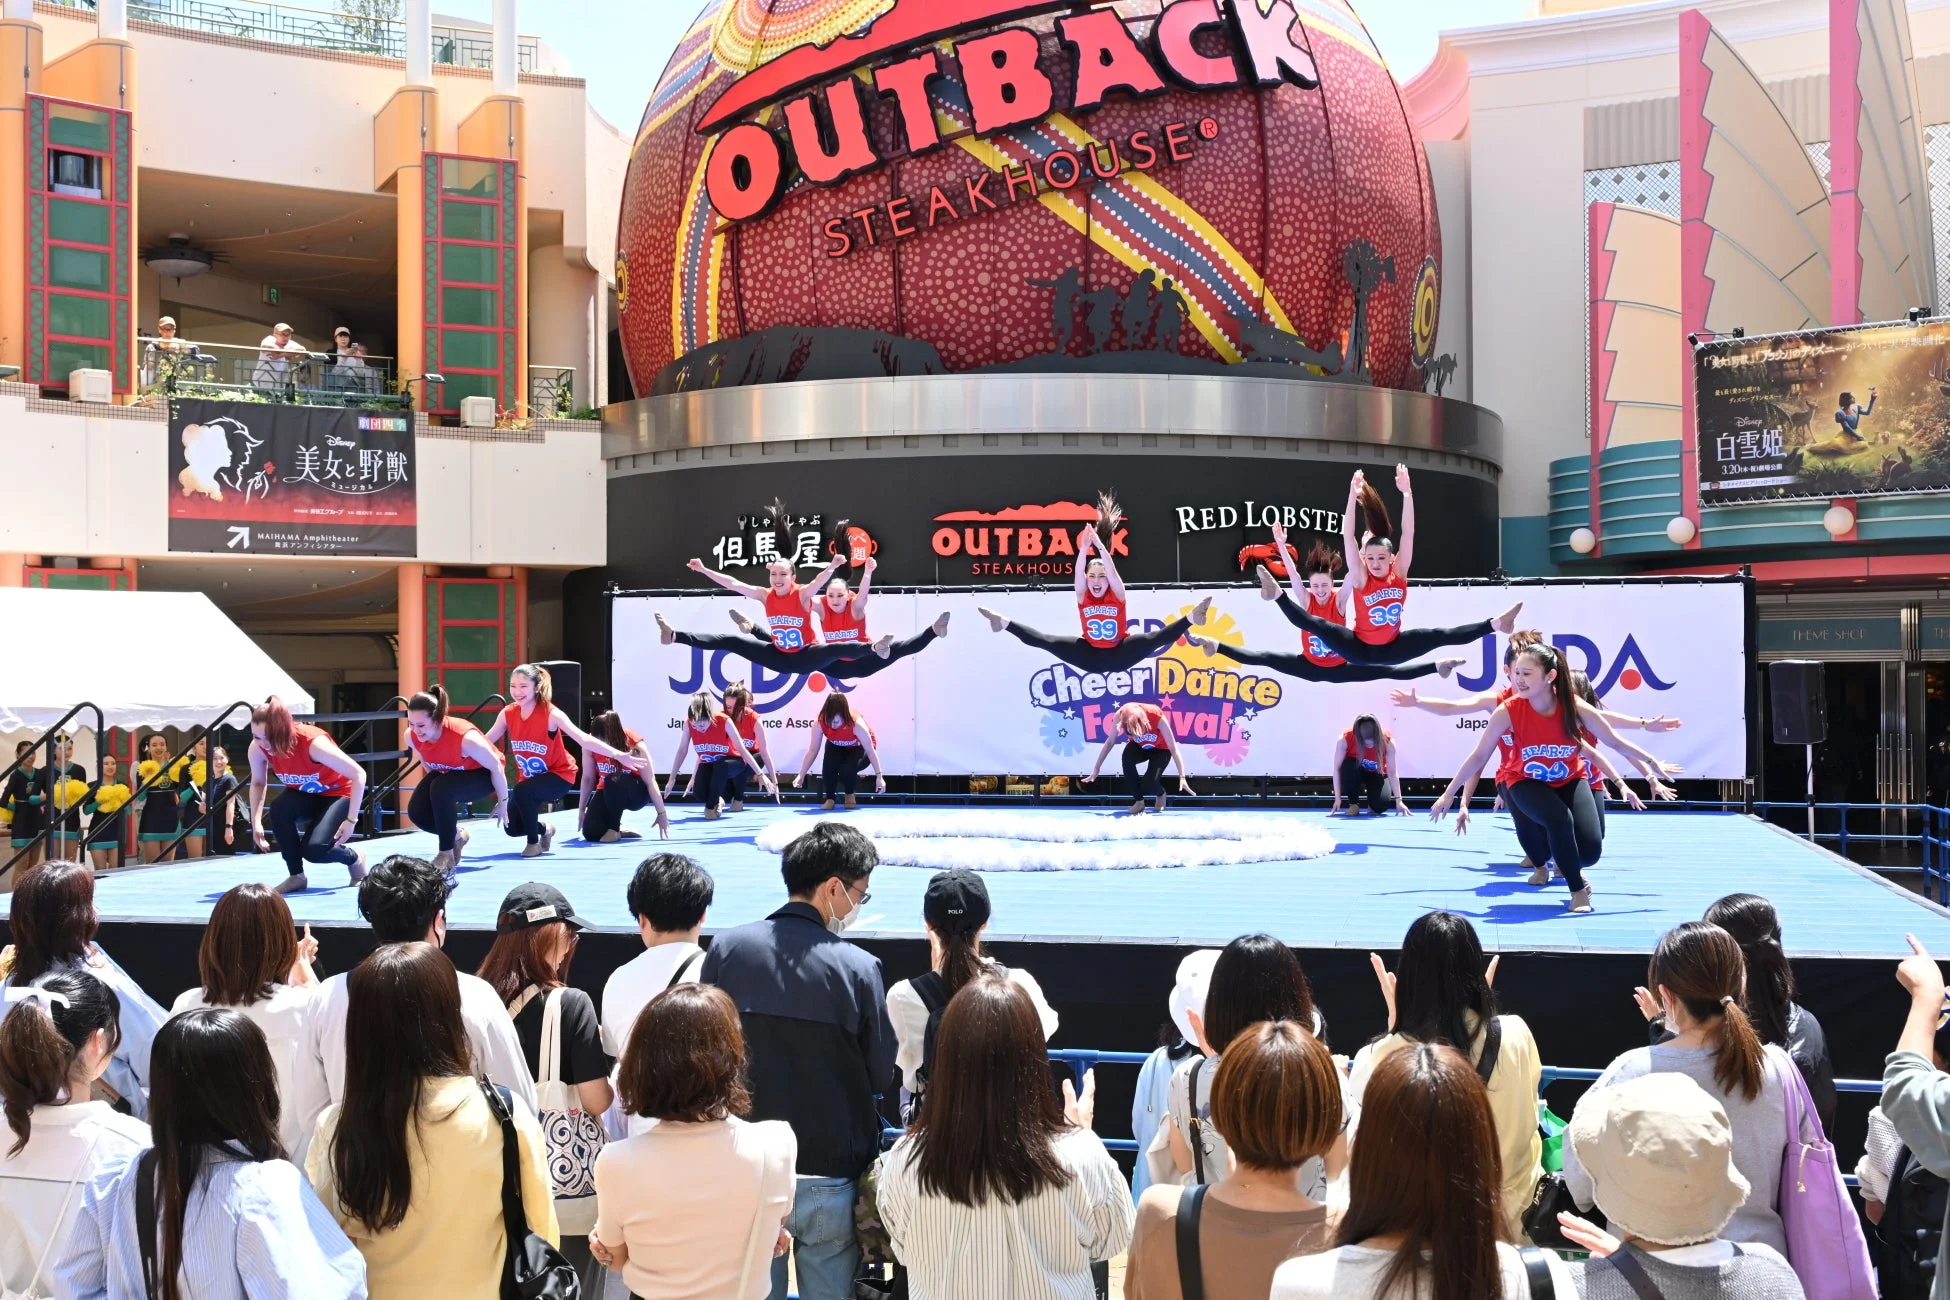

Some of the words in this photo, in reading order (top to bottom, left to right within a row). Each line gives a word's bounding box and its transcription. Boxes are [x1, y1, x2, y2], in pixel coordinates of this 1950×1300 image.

[705, 0, 1320, 222] OUTBACK
[1734, 416, 1762, 427] Disney
[324, 434, 356, 450] Disney
[1716, 428, 1788, 462] 白雪姫
[296, 444, 408, 483] 美女と野獣
[331, 482, 373, 491] ミュージカル
[751, 514, 821, 528] しゃしゃぶ
[1176, 506, 1238, 534] RED
[1244, 501, 1346, 535] LOBSTE
[303, 534, 360, 542] Amphitheater
[713, 531, 833, 570] 但馬屋
[972, 562, 1073, 575] STEAKHOUS
[1363, 587, 1404, 606] HEARTS
[1083, 606, 1118, 618] HEARTS
[1368, 602, 1403, 626] 39
[771, 628, 804, 649] 39
[1086, 618, 1119, 640] 39
[1456, 632, 1678, 701] JDA
[1030, 664, 1151, 707] Cheer
[1157, 659, 1282, 707] Dance
[1082, 701, 1234, 741] Feval
[1456, 717, 1489, 732] Japa
[510, 740, 548, 755] EARTS
[1524, 760, 1570, 782] 39
